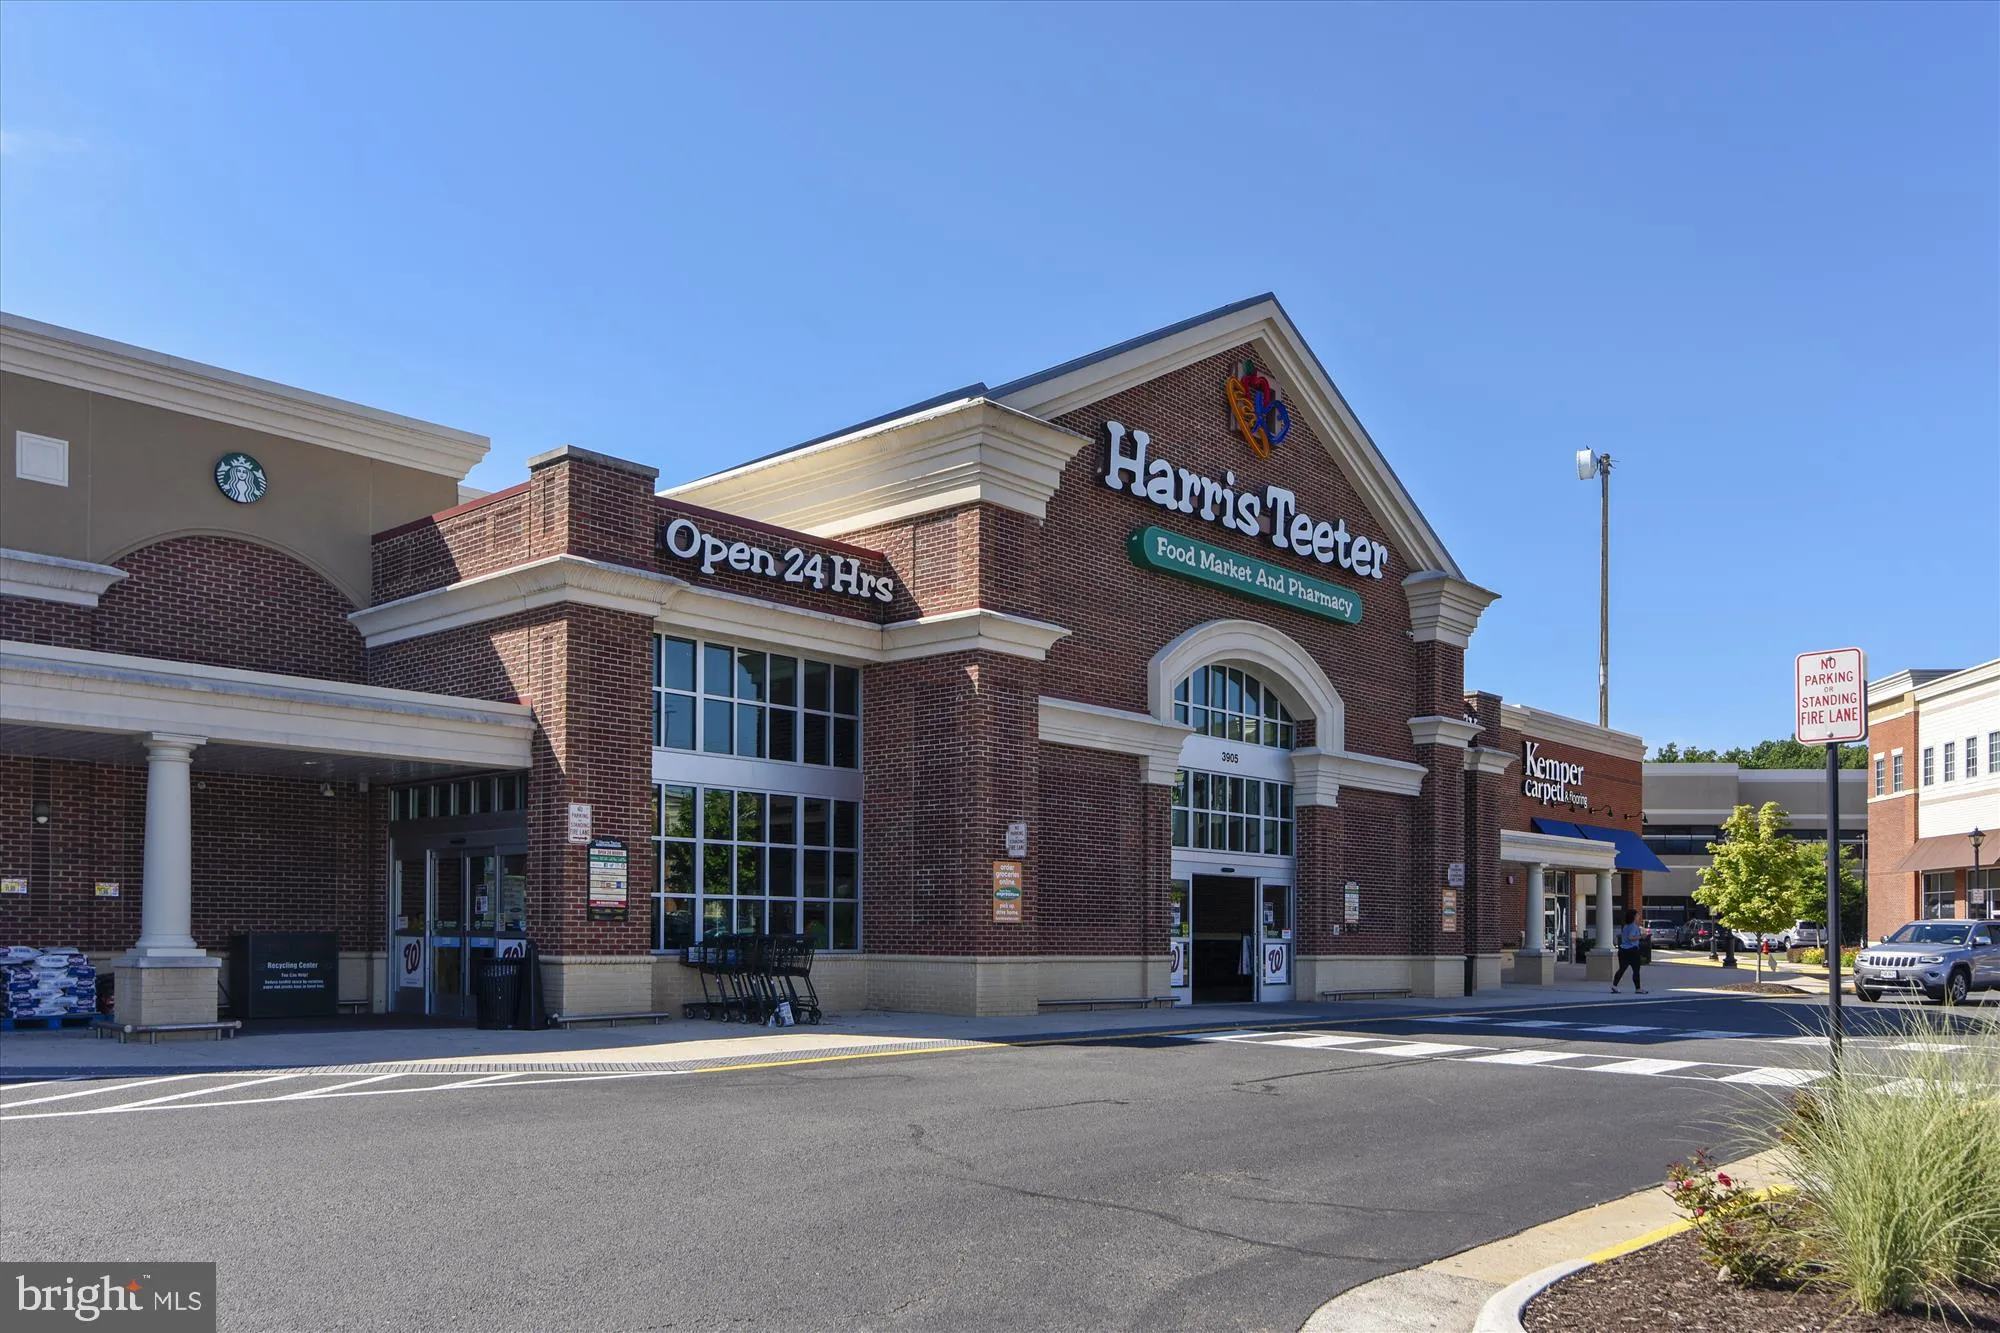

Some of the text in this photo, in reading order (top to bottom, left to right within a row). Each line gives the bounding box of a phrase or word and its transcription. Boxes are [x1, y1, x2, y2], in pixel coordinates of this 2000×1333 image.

[1105, 420, 1388, 580] Harris Teeter
[666, 518, 894, 603] Open 24 Hrs
[1157, 537, 1354, 619] Food Market And Pharmacy
[1820, 658, 1837, 670] NO
[1804, 670, 1853, 686] PARKING
[1801, 692, 1857, 709] STANDING
[1801, 706, 1859, 726] FIRE LANE
[1221, 751, 1239, 764] 3905
[1525, 741, 1584, 801] Kemper
